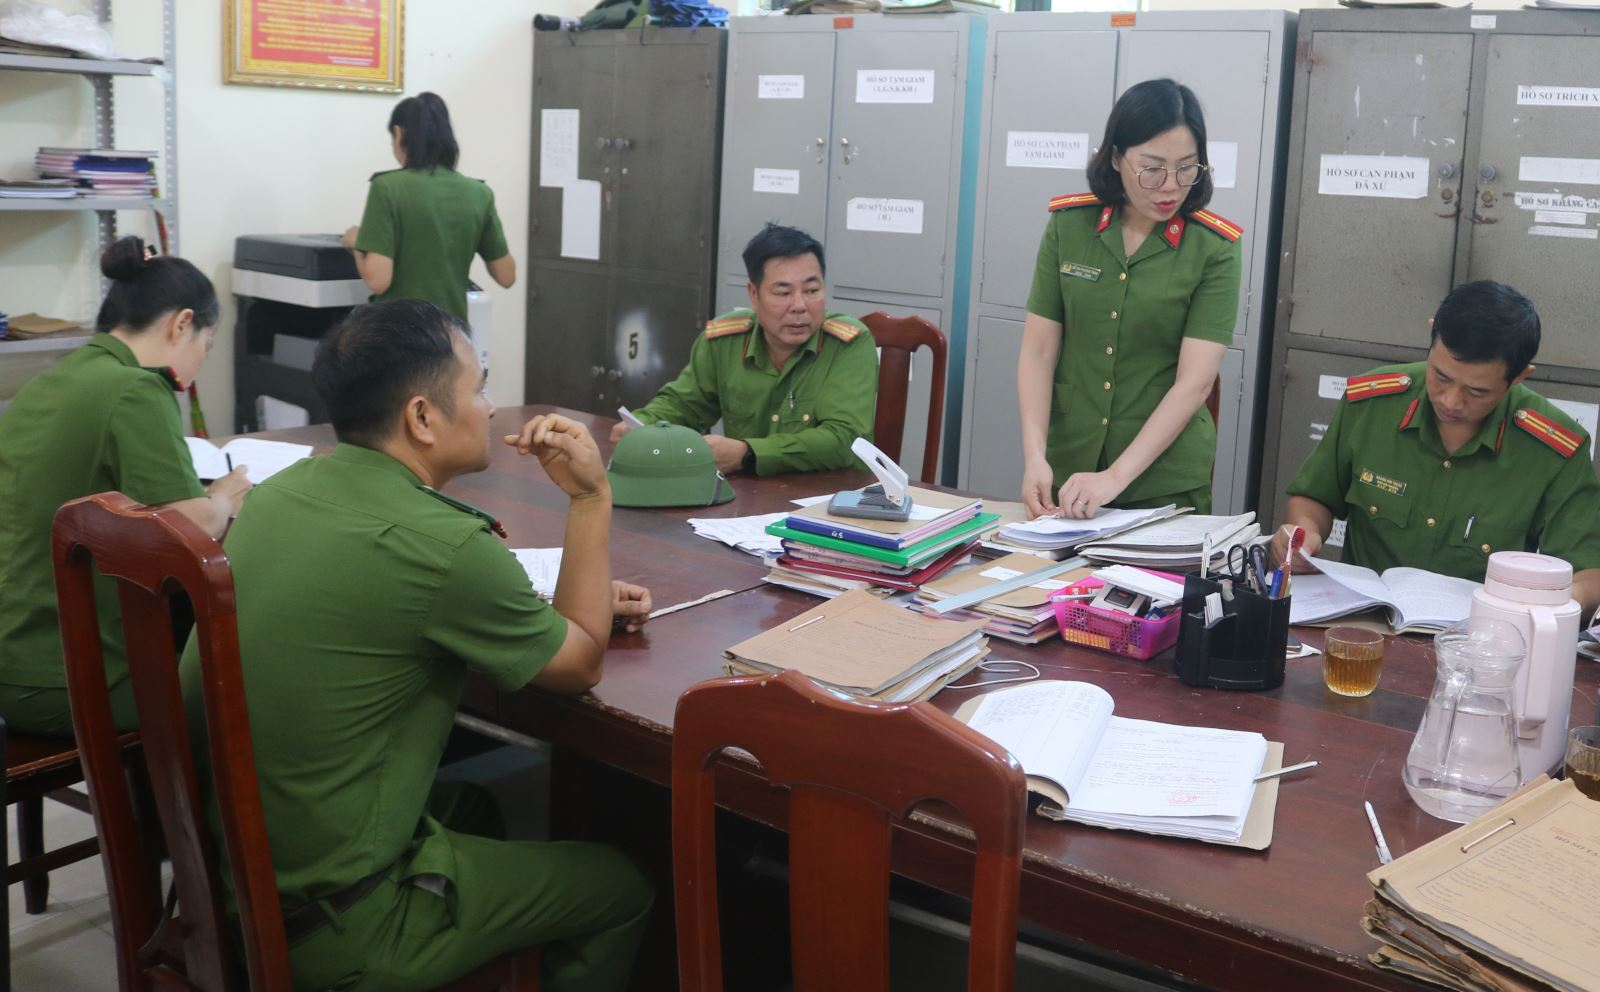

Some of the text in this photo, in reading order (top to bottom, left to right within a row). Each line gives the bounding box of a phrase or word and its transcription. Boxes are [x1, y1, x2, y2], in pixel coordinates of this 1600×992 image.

[1556, 91, 1589, 101] TRÍCH
[1384, 169, 1415, 181] PHẠM
[629, 332, 638, 360] 5
